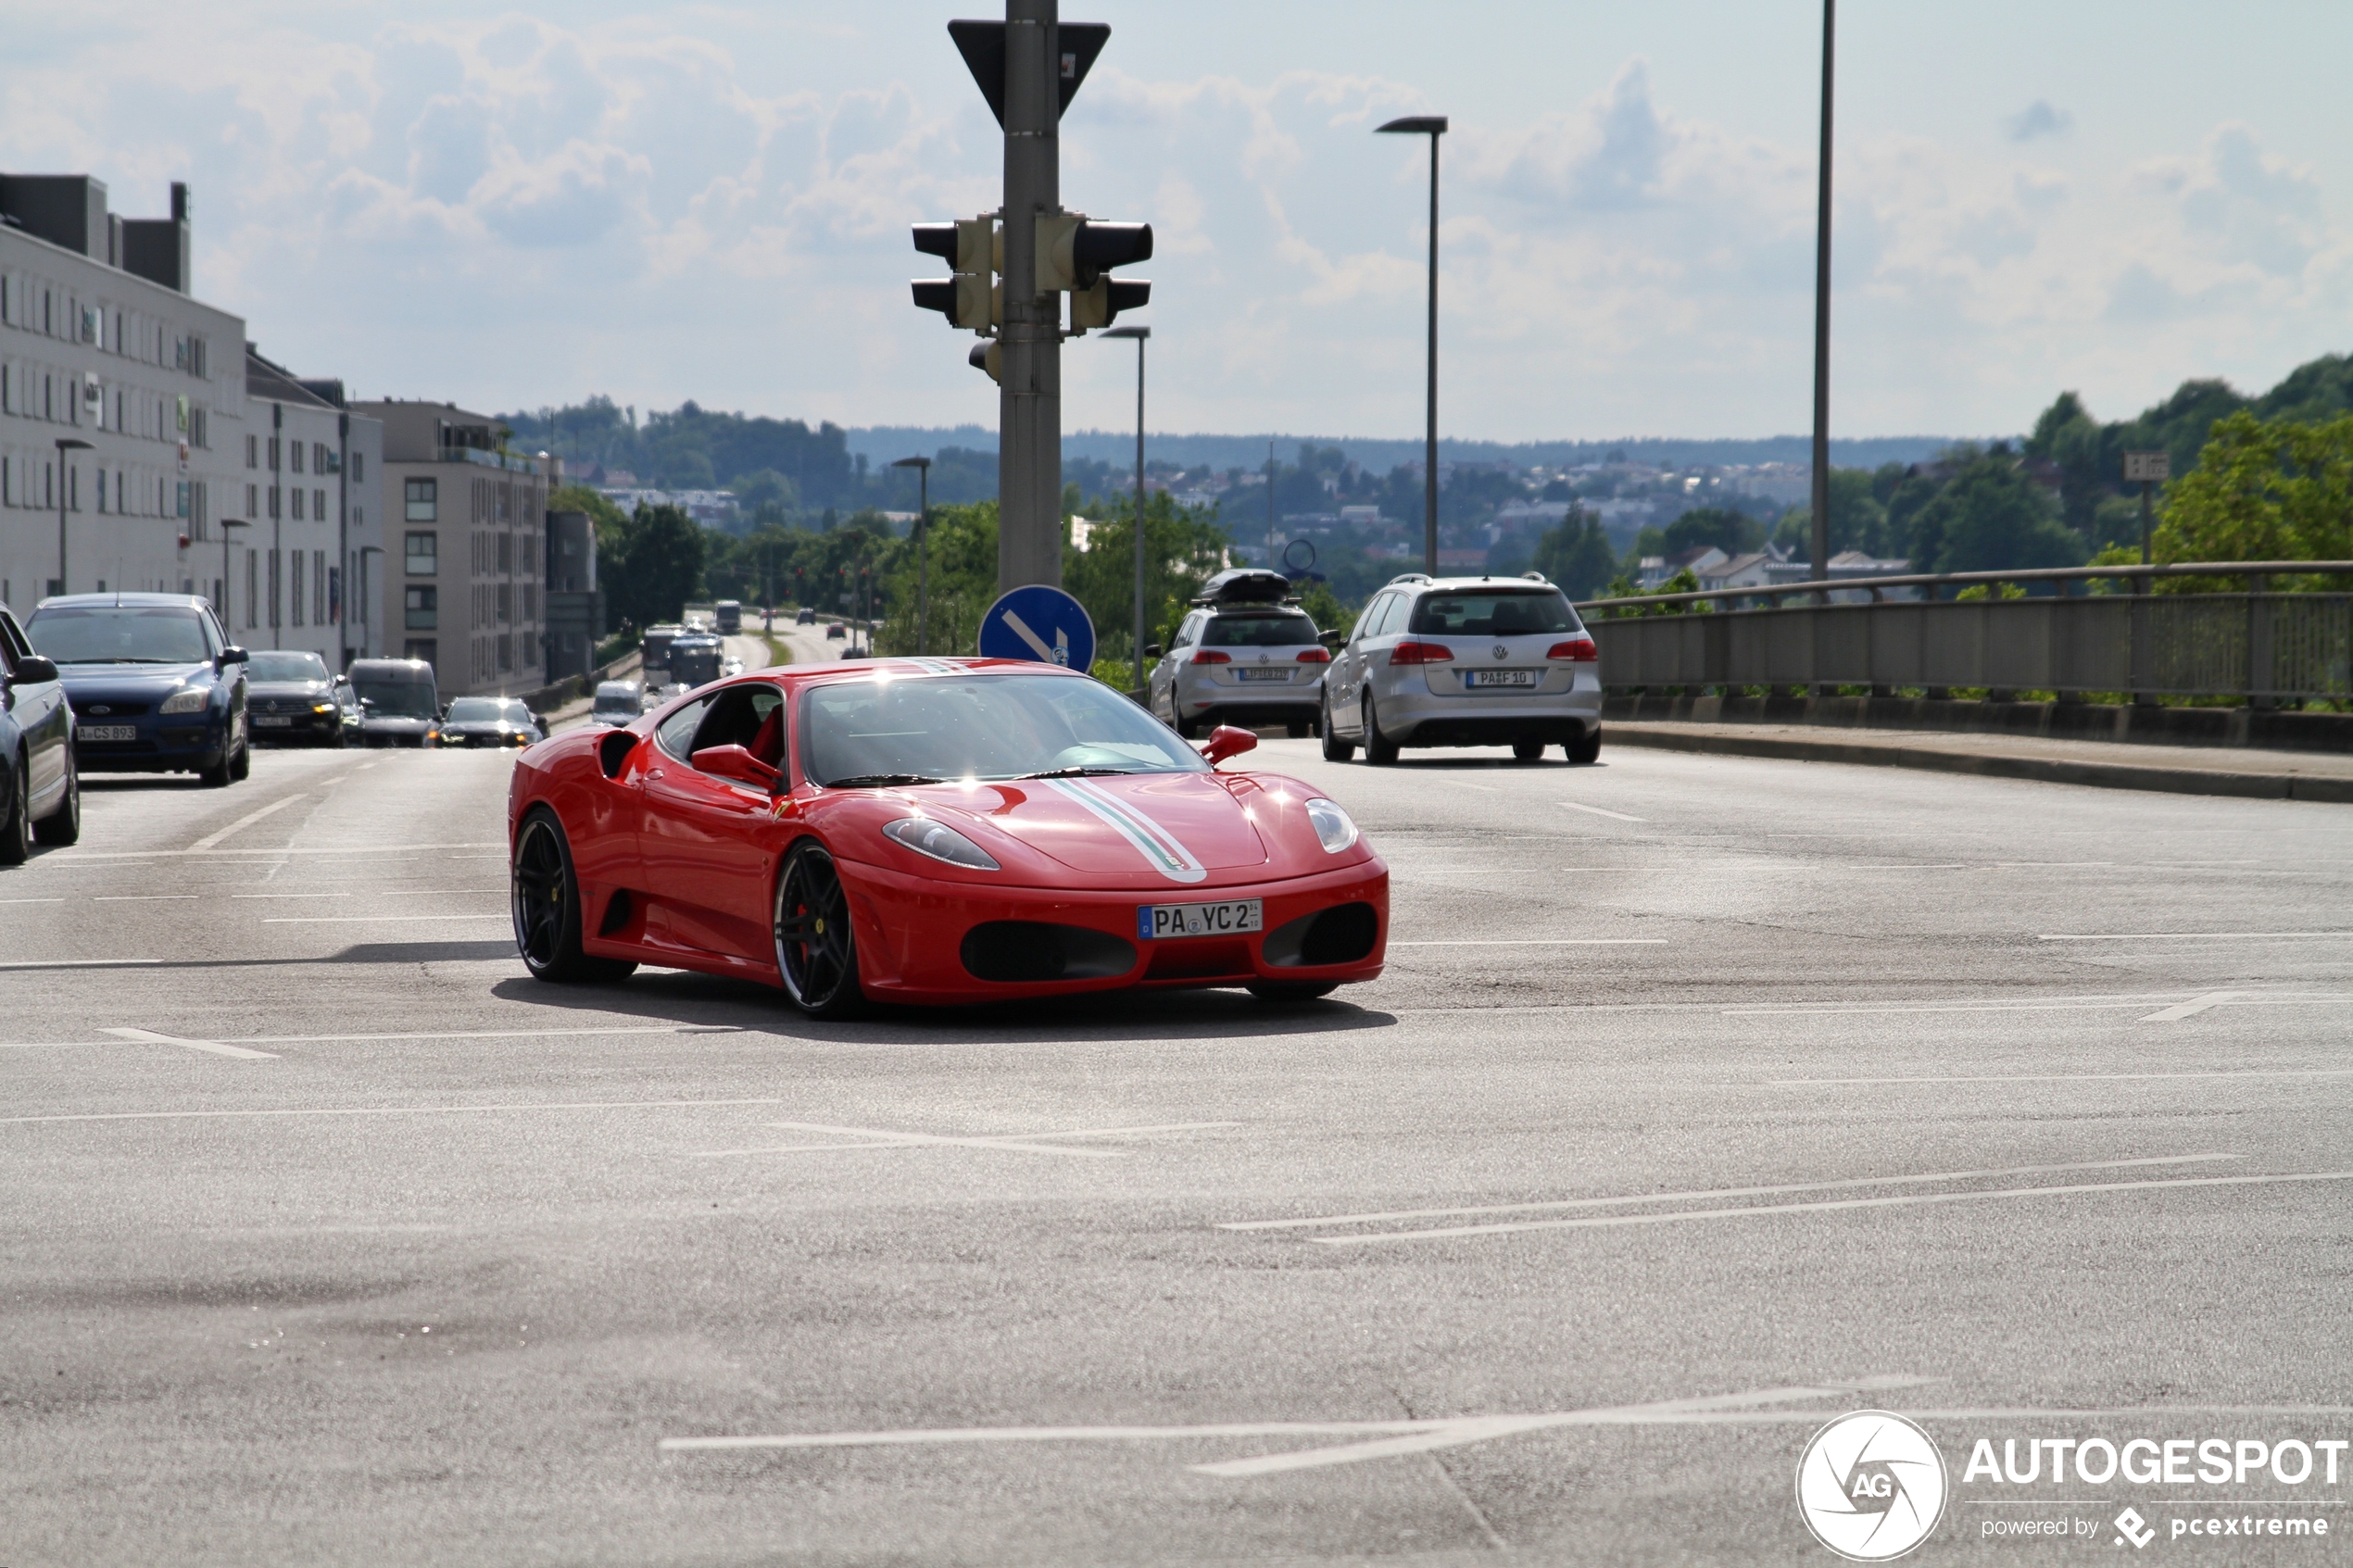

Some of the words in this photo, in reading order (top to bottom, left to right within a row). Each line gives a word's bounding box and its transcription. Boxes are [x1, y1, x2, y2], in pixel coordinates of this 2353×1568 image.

[1274, 669, 1288, 678] 219
[1480, 672, 1496, 684] PA
[1503, 672, 1510, 684] F
[1513, 672, 1527, 684] 10
[94, 727, 109, 739] CS
[112, 727, 134, 739] 893
[1154, 909, 1186, 934] PA
